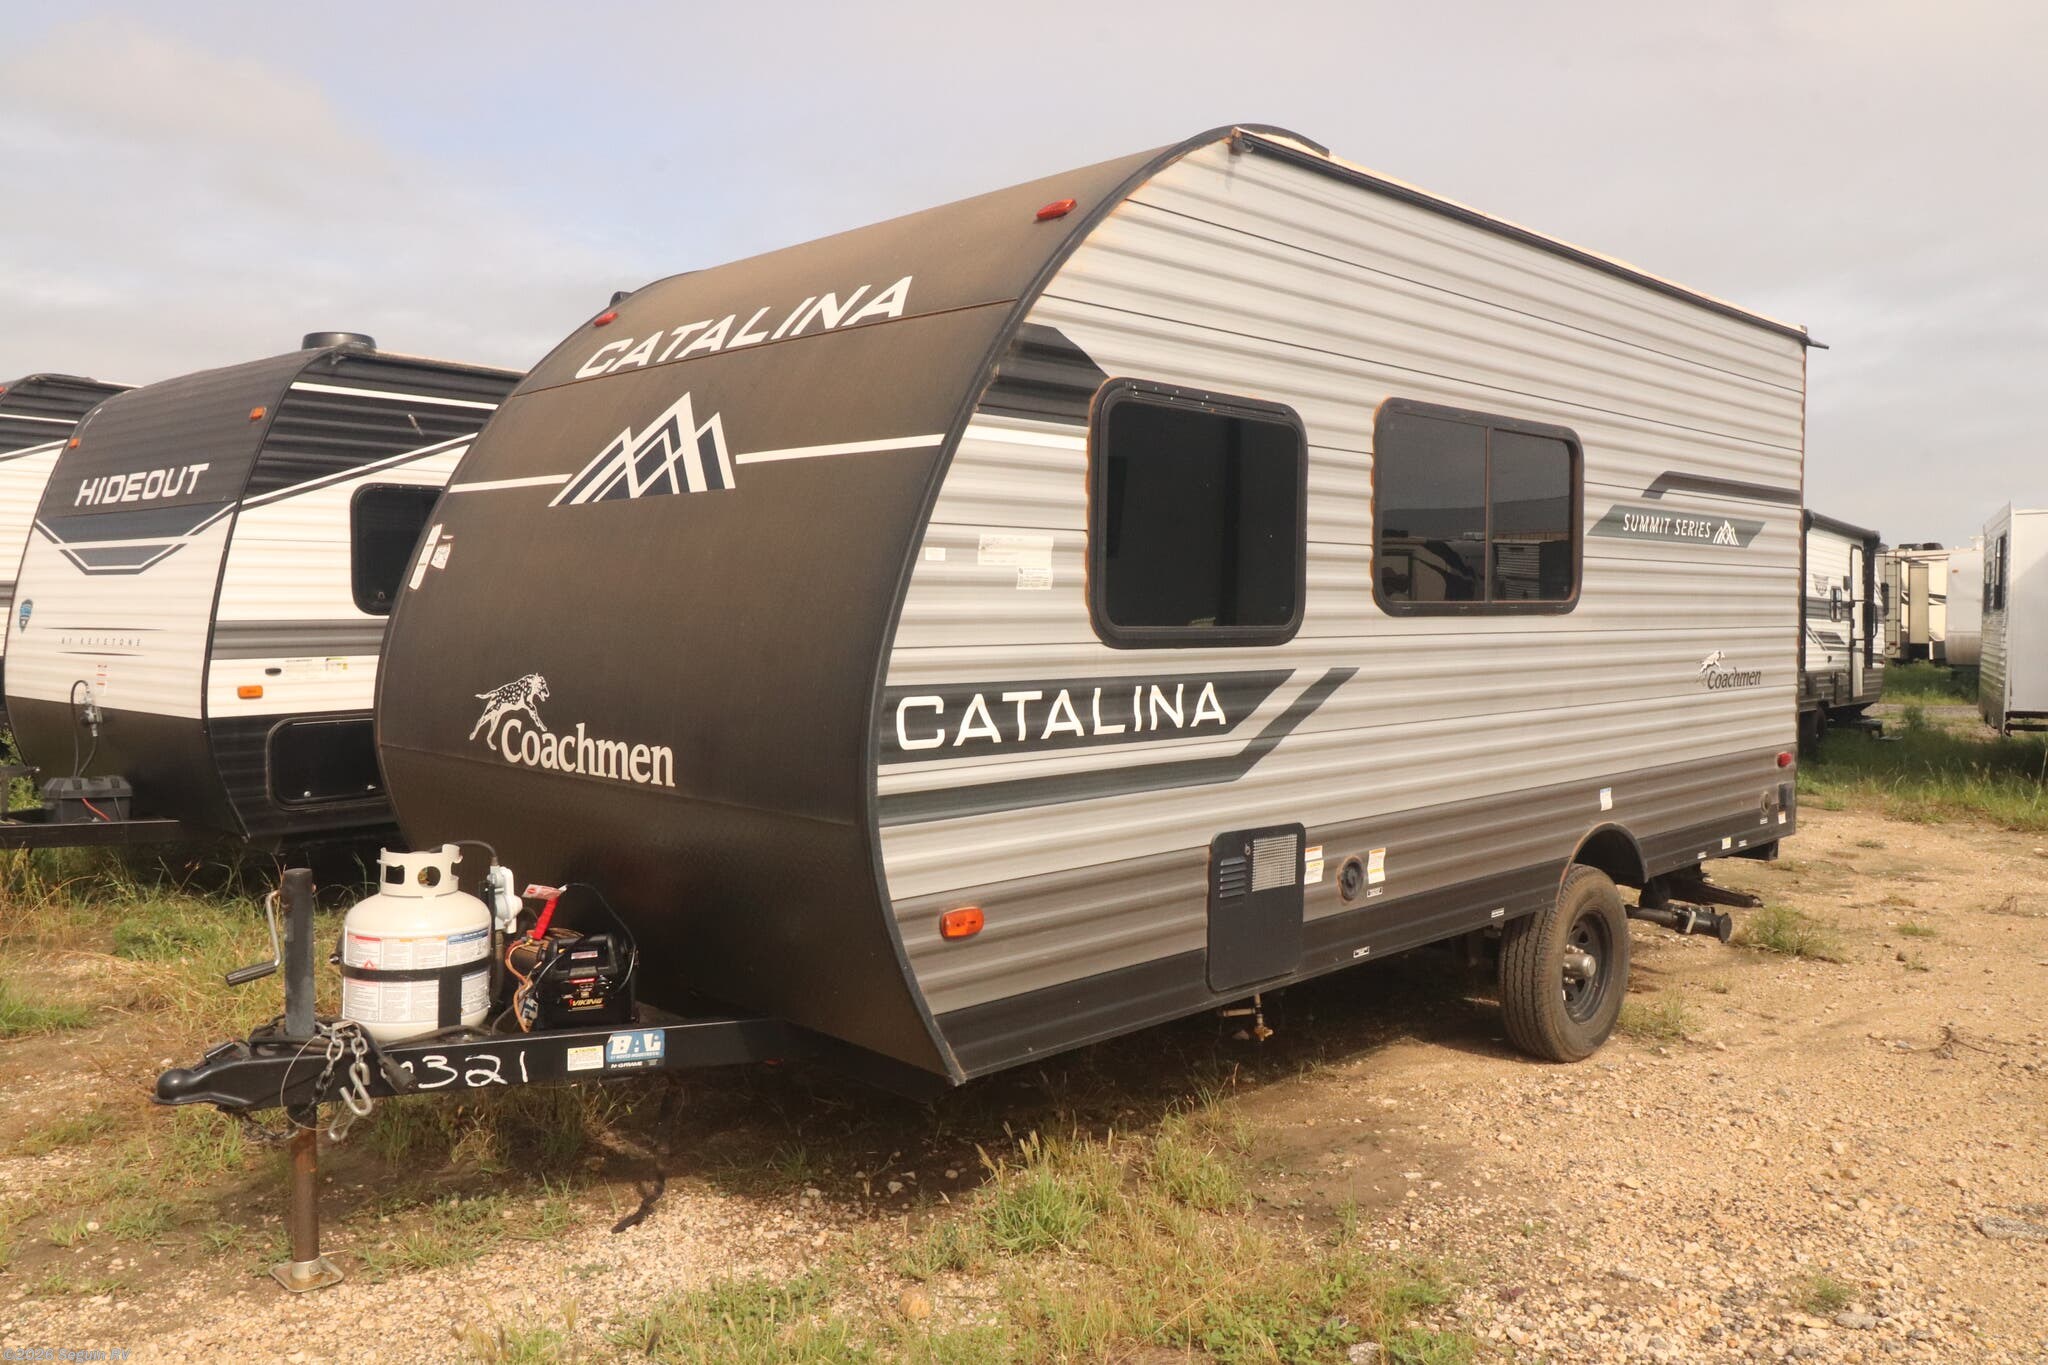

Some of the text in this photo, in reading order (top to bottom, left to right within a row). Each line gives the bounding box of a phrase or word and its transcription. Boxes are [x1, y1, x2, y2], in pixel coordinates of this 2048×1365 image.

[575, 275, 913, 379] CATALINA
[74, 462, 210, 507] HIDEOUT
[1623, 513, 1712, 538] SUMMIT SERIES
[1707, 666, 1762, 690] Coachmen
[896, 681, 1227, 751] CATALINA
[501, 718, 676, 788] Coachmen
[572, 997, 604, 1006] VIKING
